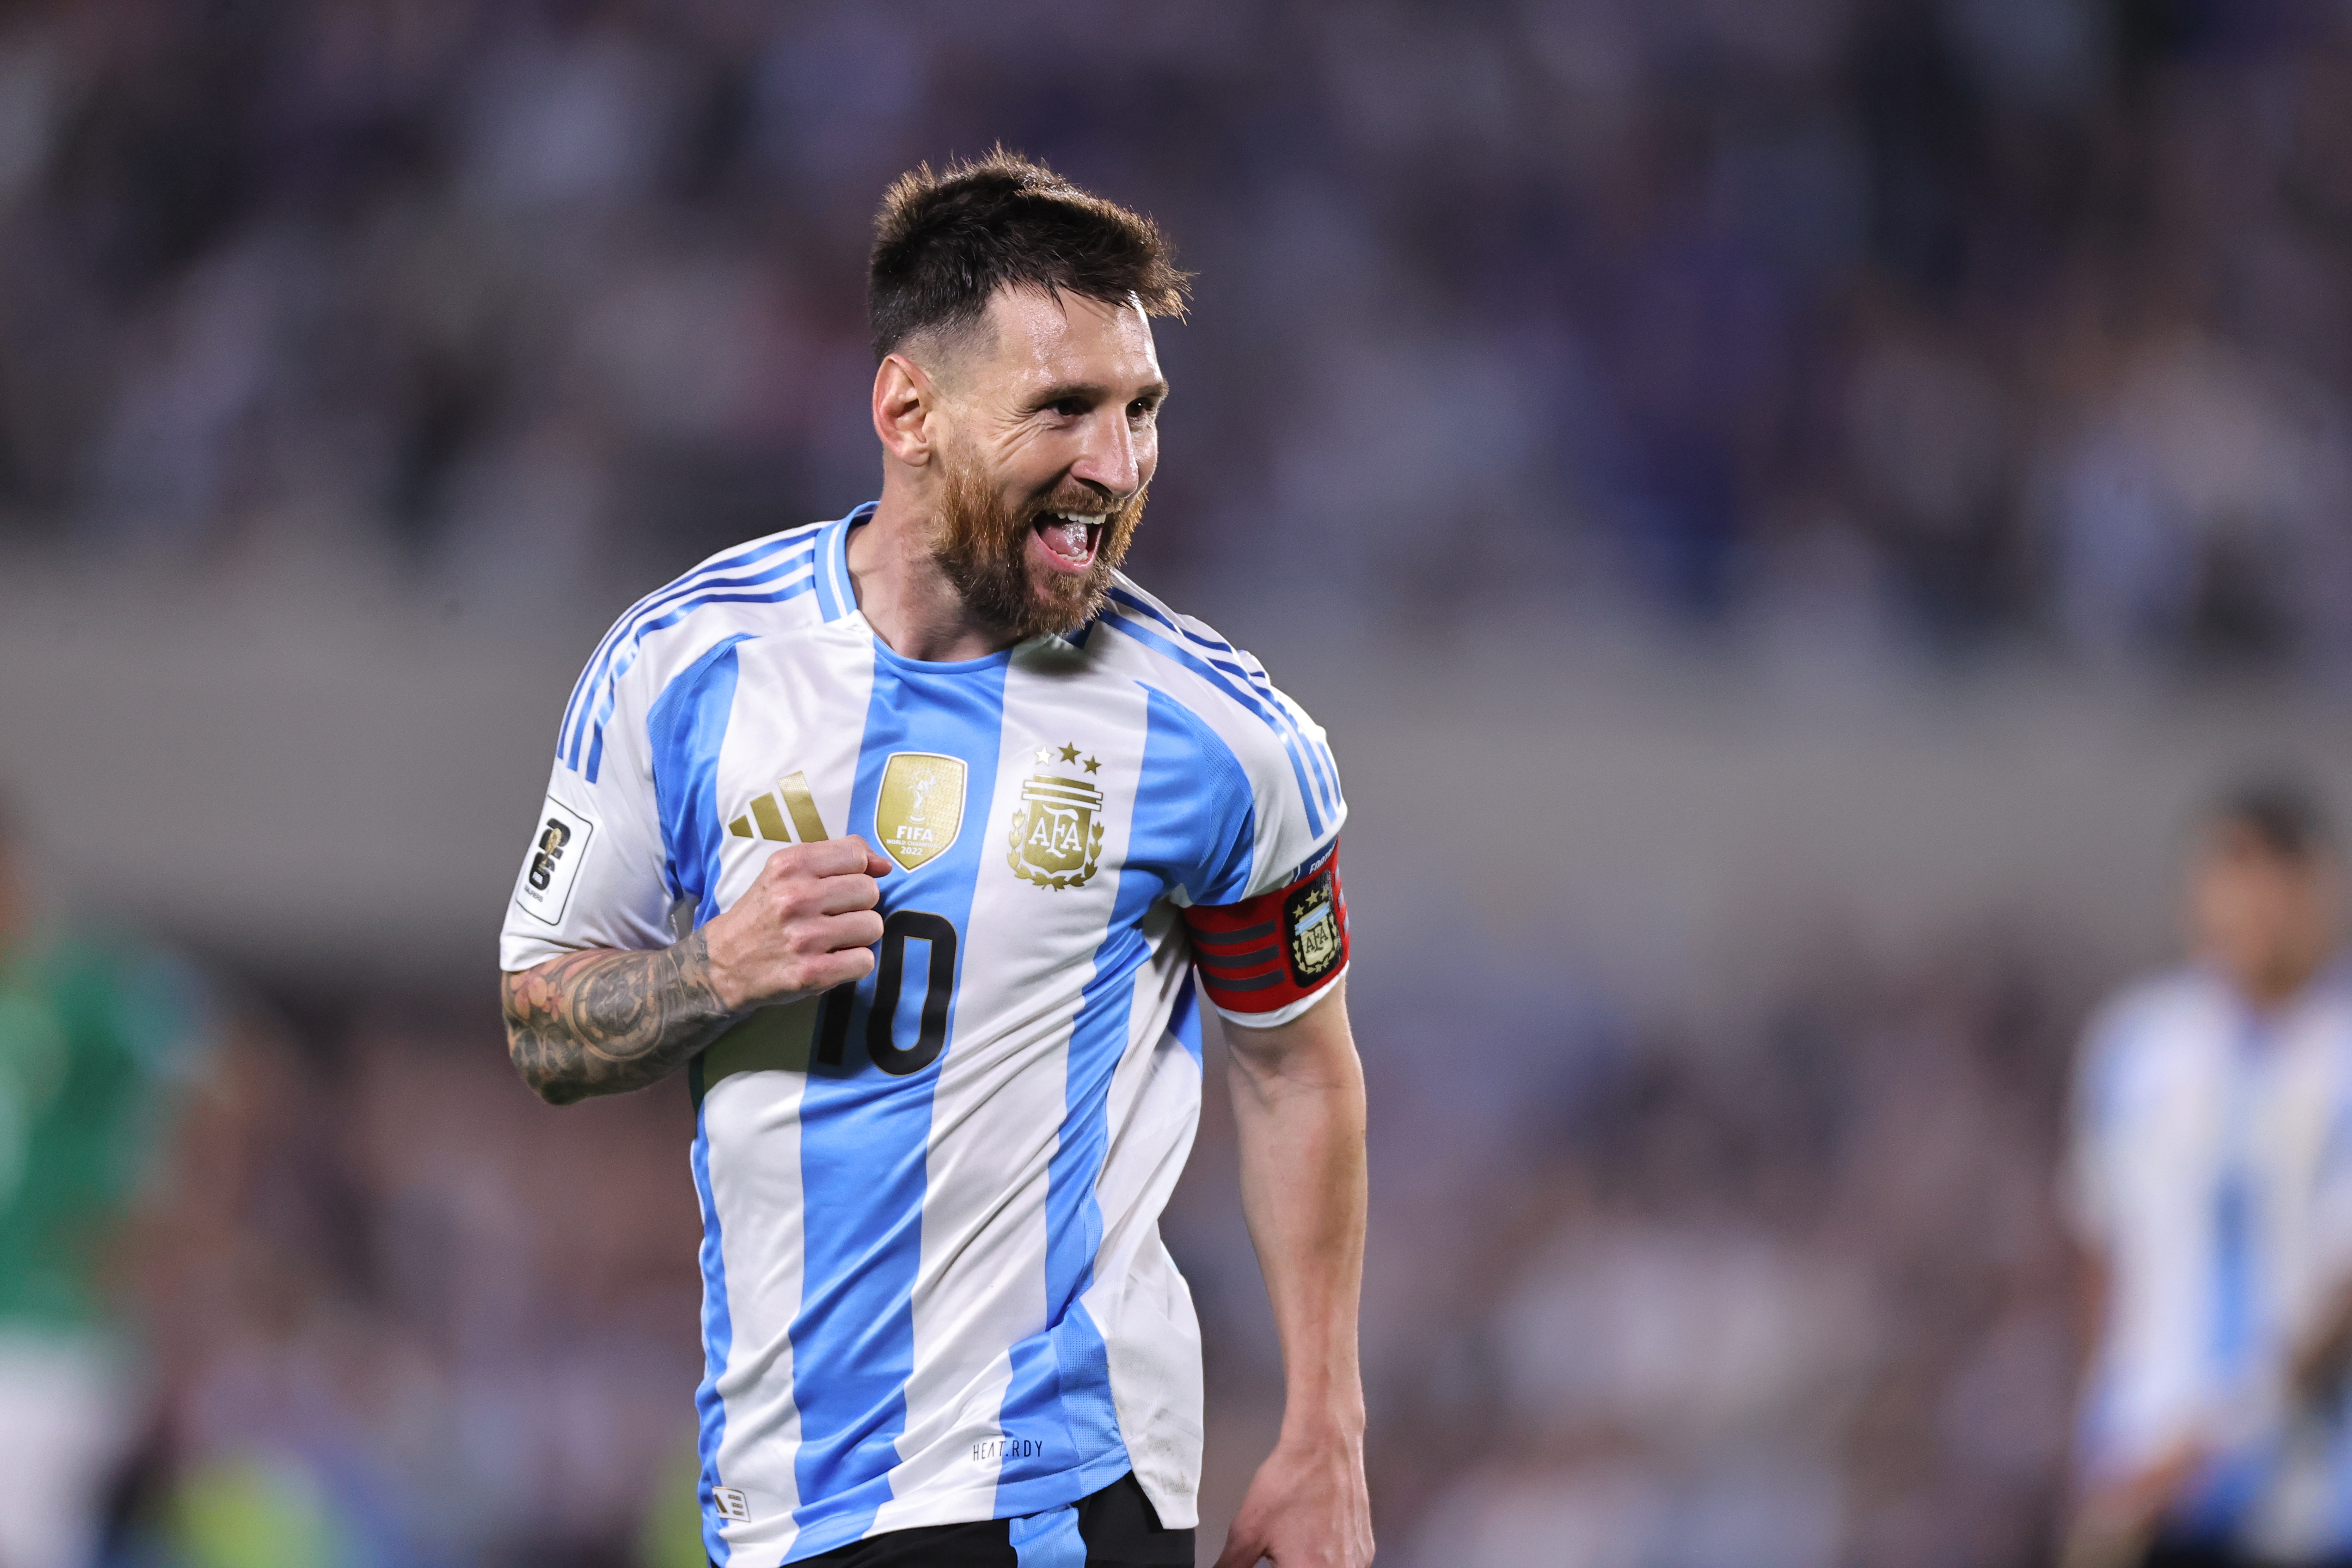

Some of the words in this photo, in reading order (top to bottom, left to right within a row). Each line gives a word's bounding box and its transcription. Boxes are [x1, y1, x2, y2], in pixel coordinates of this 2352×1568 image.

[896, 825, 933, 842] FIFA
[1028, 804, 1082, 858] AFA
[900, 846, 923, 855] 2022
[1305, 922, 1328, 953] AFA
[973, 1440, 1042, 1461] HEAT.RDY
